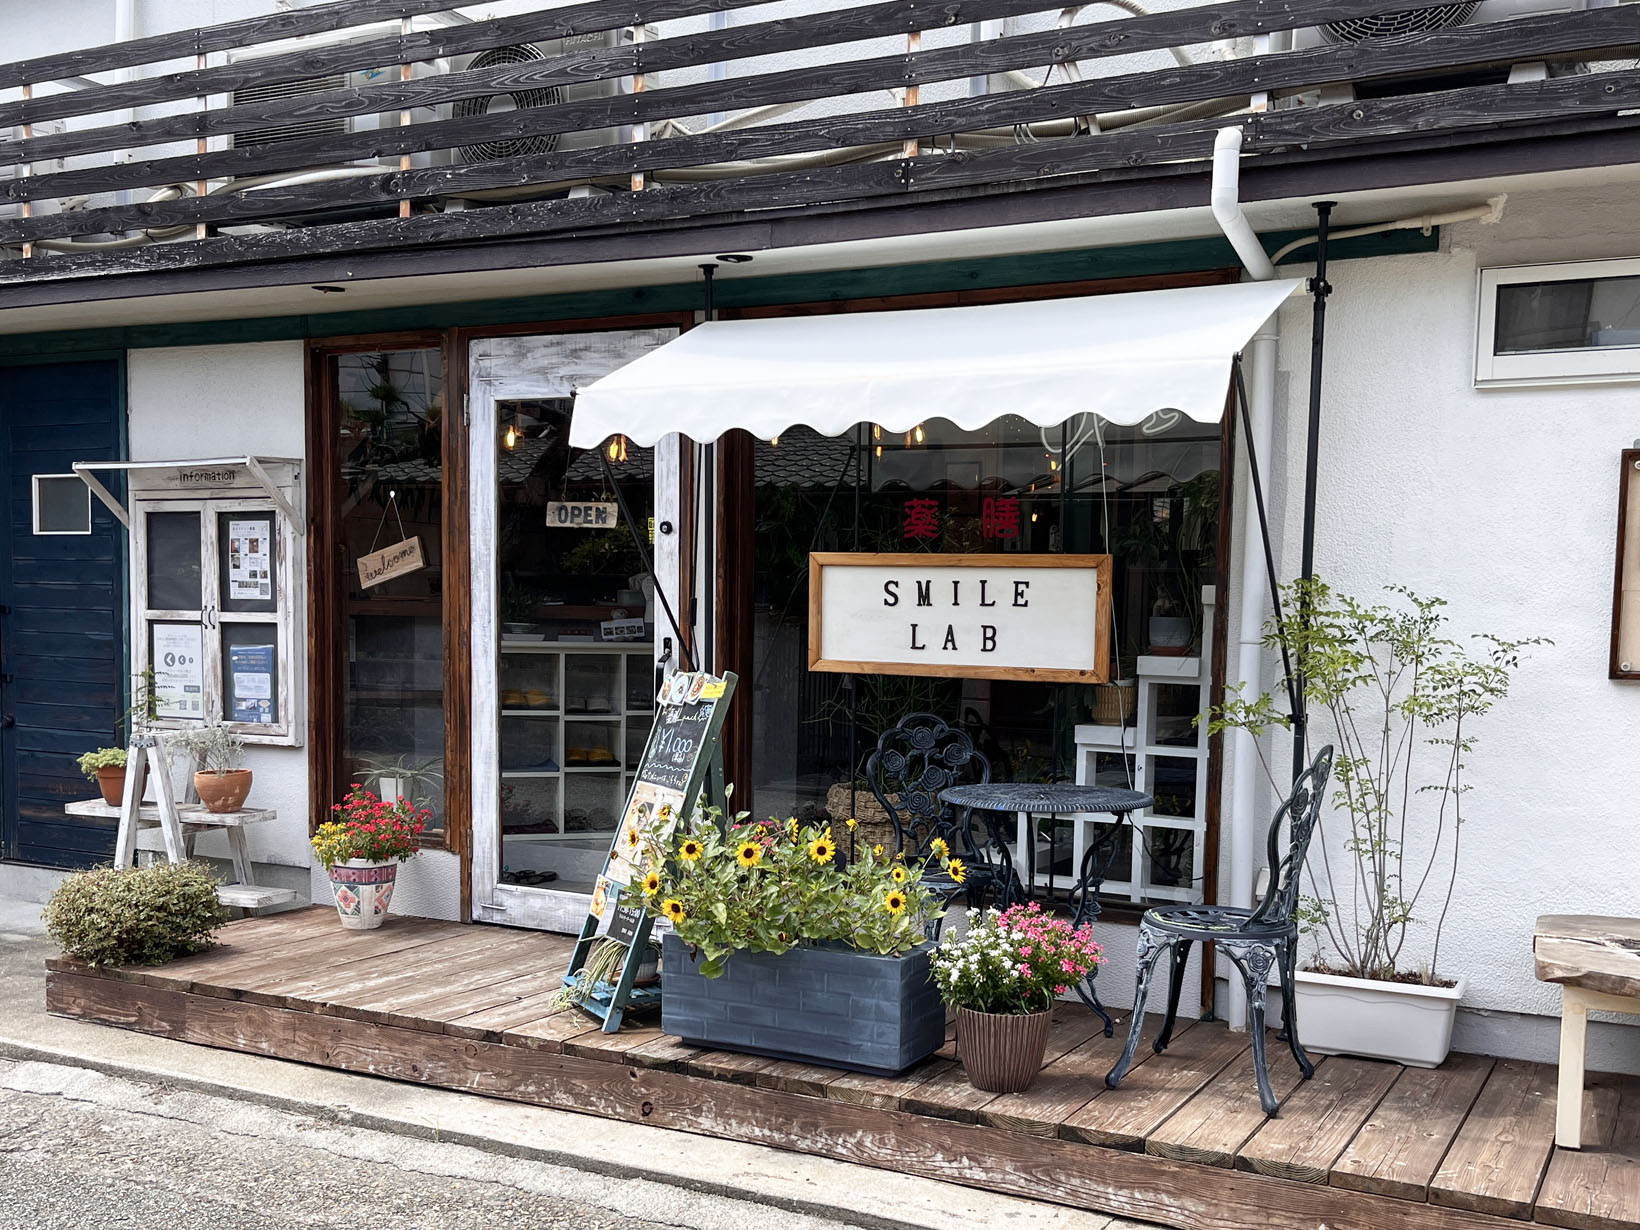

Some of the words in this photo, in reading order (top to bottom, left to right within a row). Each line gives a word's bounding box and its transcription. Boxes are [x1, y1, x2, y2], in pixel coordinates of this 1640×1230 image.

[557, 505, 608, 524] OPEN
[903, 496, 1020, 539] 薬膳
[883, 580, 1030, 607] SMILE
[910, 624, 997, 652] LAB
